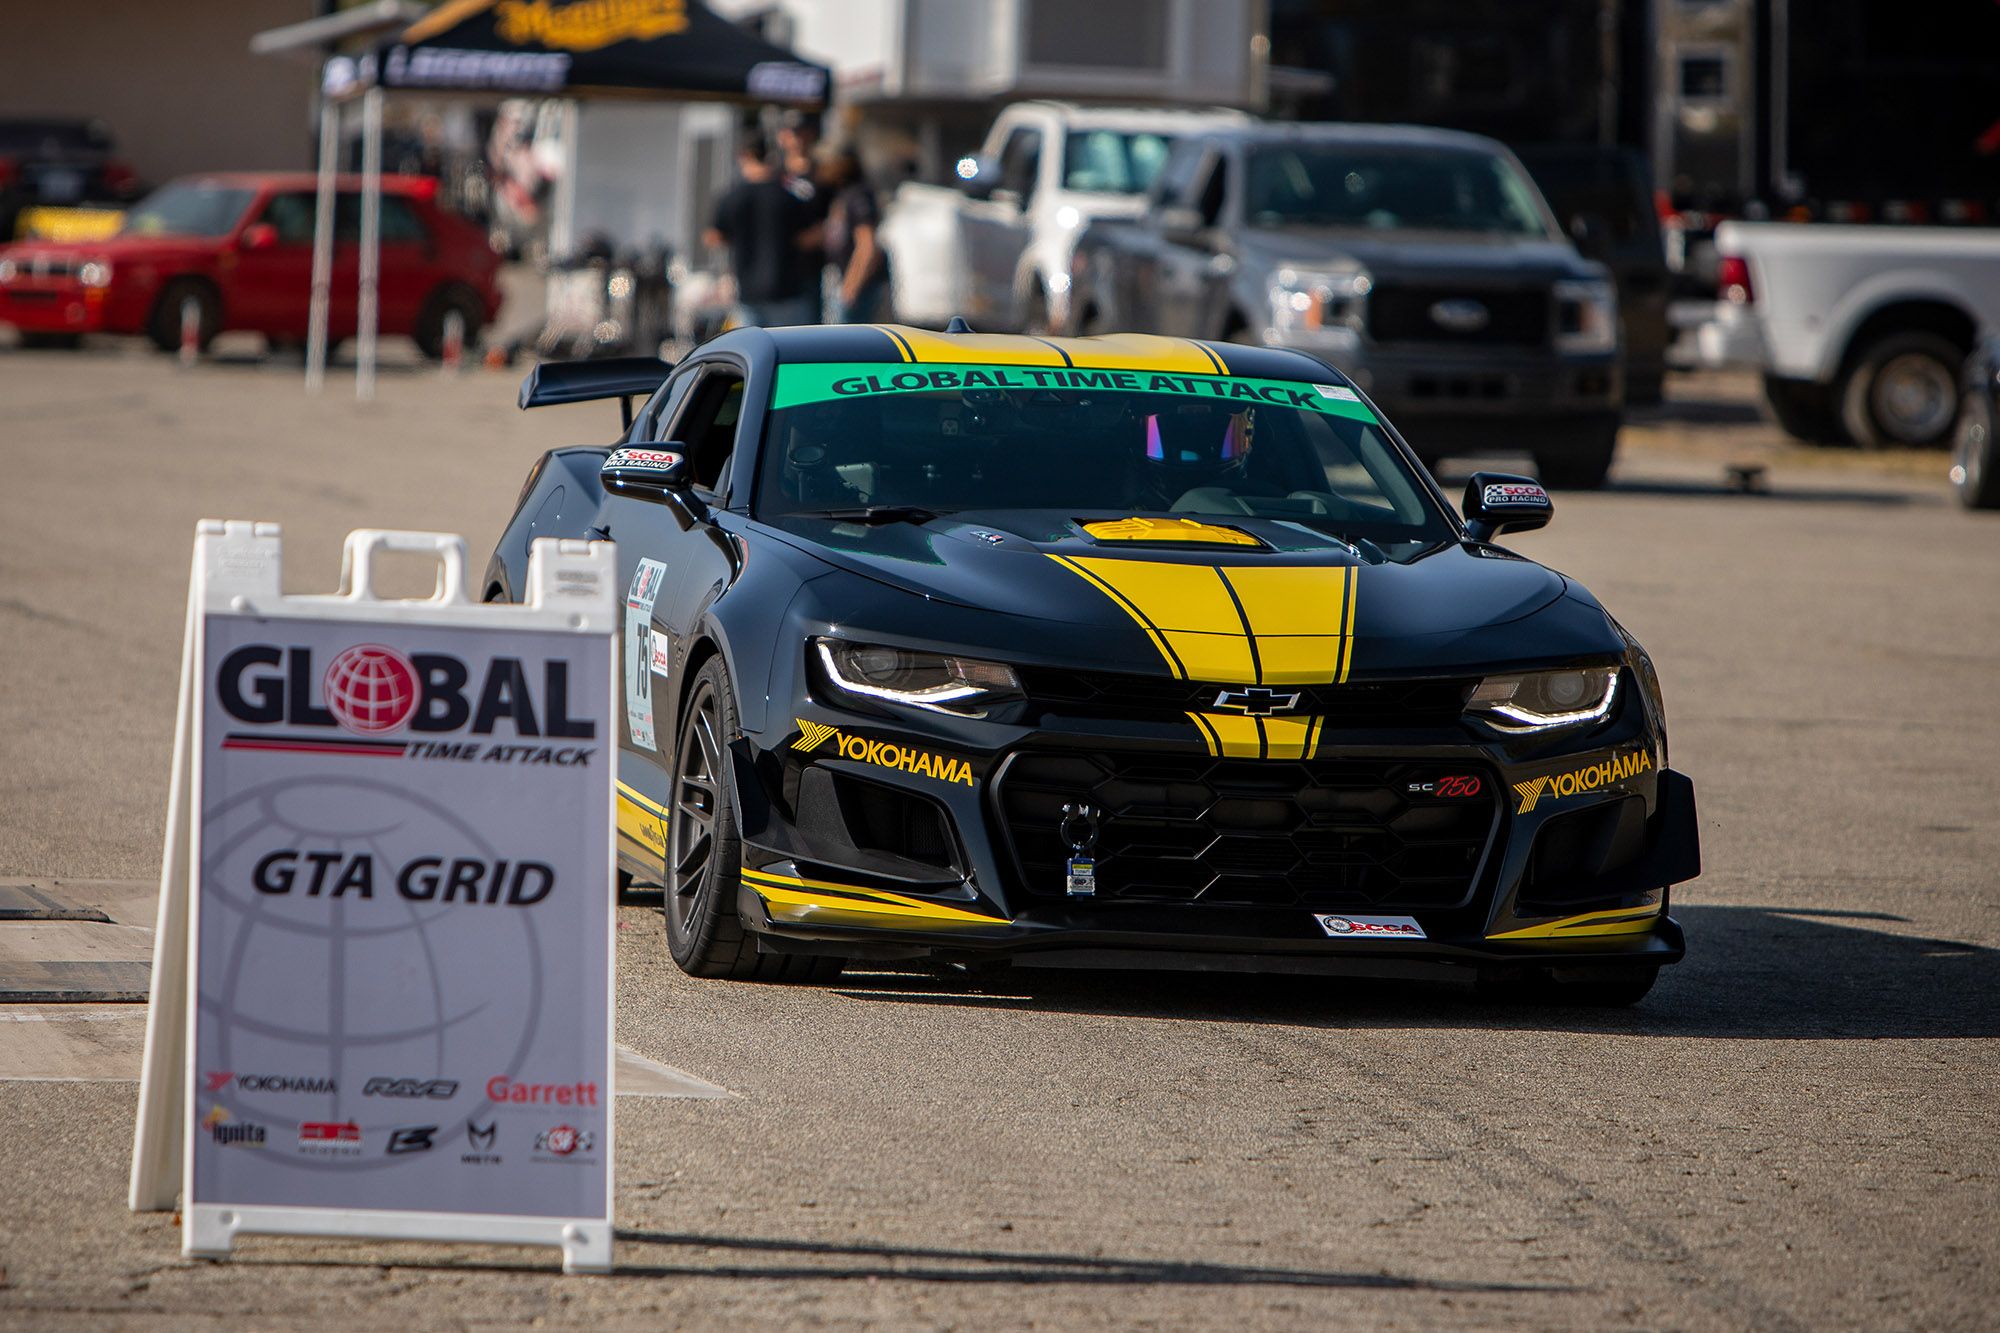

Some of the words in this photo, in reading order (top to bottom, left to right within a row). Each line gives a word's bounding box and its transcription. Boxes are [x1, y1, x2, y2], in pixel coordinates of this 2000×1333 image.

[831, 370, 1022, 395] GLOBAL
[1022, 369, 1141, 391] TIME
[1146, 375, 1323, 410] ATTACK
[626, 460, 670, 469] RACING
[627, 451, 674, 463] SCCA
[1488, 495, 1509, 503] PRO
[1511, 495, 1546, 503] RACING
[1504, 487, 1545, 495] SCCA
[216, 643, 596, 740] GLOBAL
[408, 741, 478, 762] TIME
[479, 744, 598, 767] ATTACK
[836, 732, 974, 787] YOKOHAMA
[1548, 749, 1652, 799] YOKOHAMA
[1408, 783, 1434, 792] SC
[1436, 775, 1481, 798] 750
[253, 850, 374, 898] GTA
[395, 856, 555, 906] GRID
[1349, 923, 1419, 932] SCCA
[236, 1075, 338, 1095] YOKOHAMA
[486, 1075, 598, 1105] Garrett
